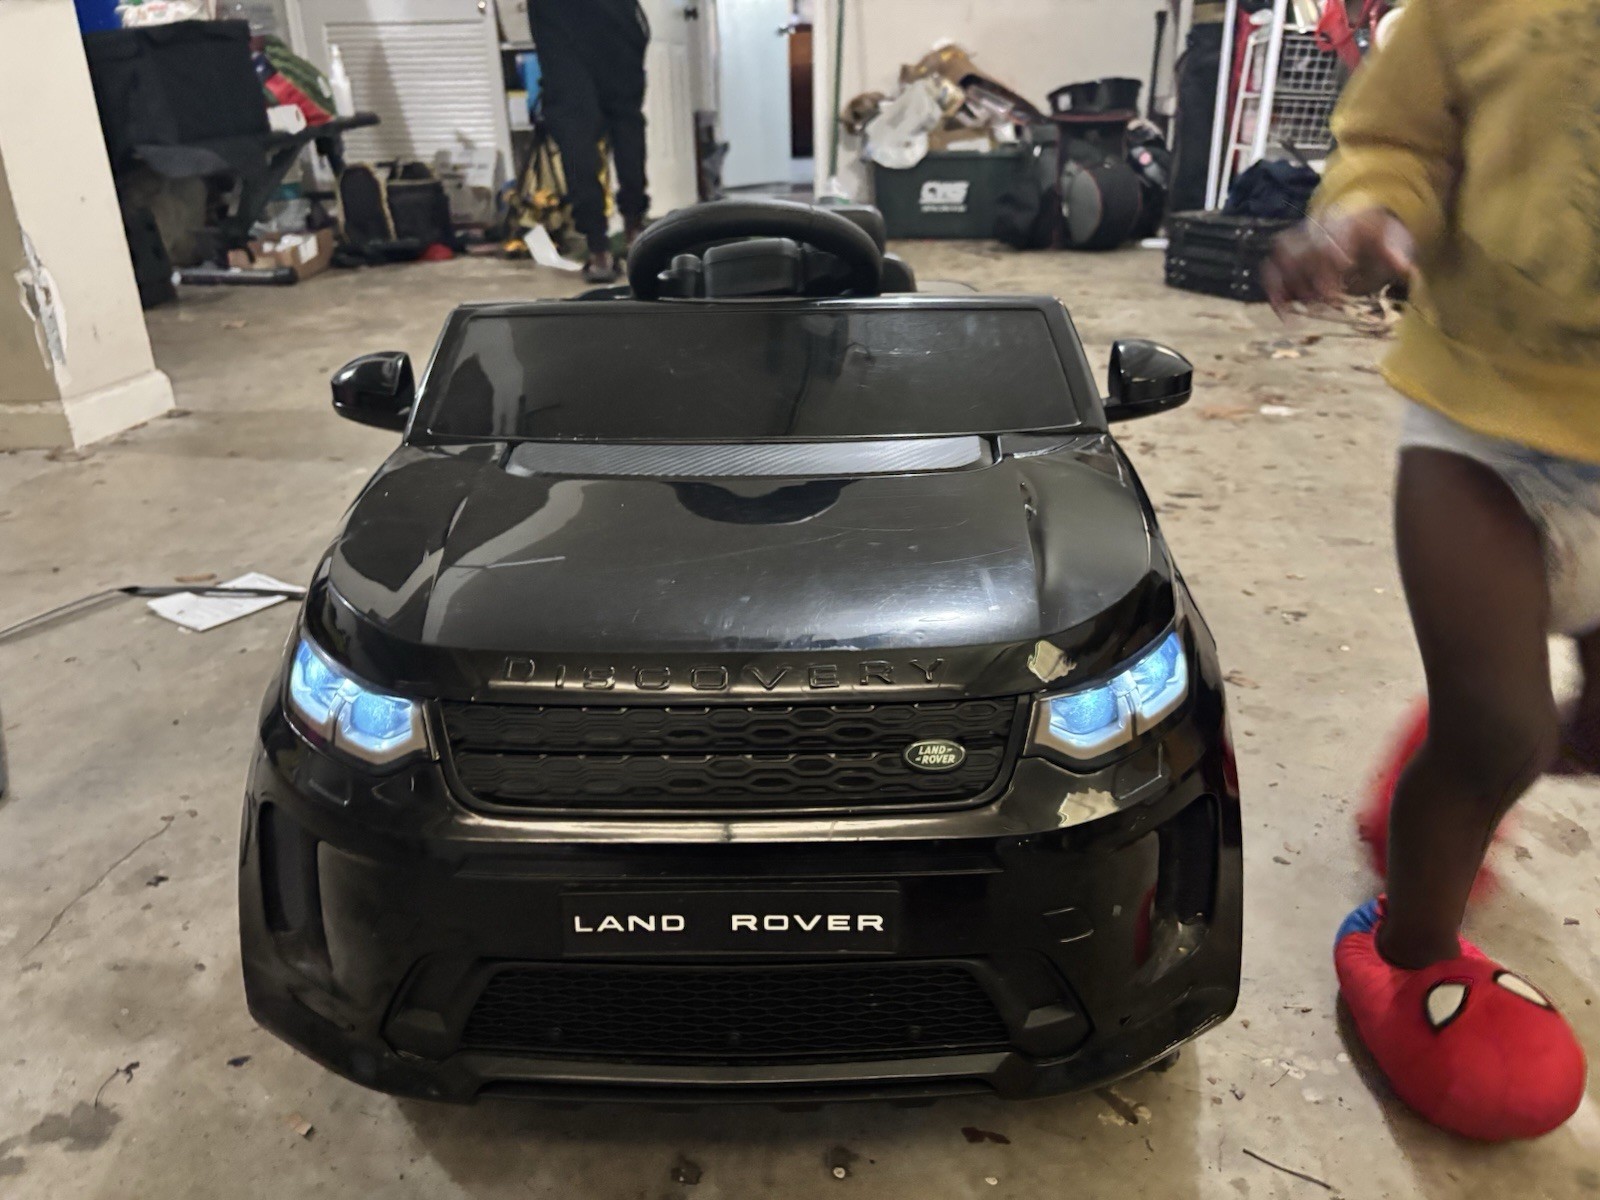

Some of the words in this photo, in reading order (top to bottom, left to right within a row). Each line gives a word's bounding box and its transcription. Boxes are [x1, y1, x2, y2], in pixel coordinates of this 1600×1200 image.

[504, 655, 945, 691] DISCOVERY
[574, 915, 685, 932] LAND
[731, 914, 884, 932] ROVER
